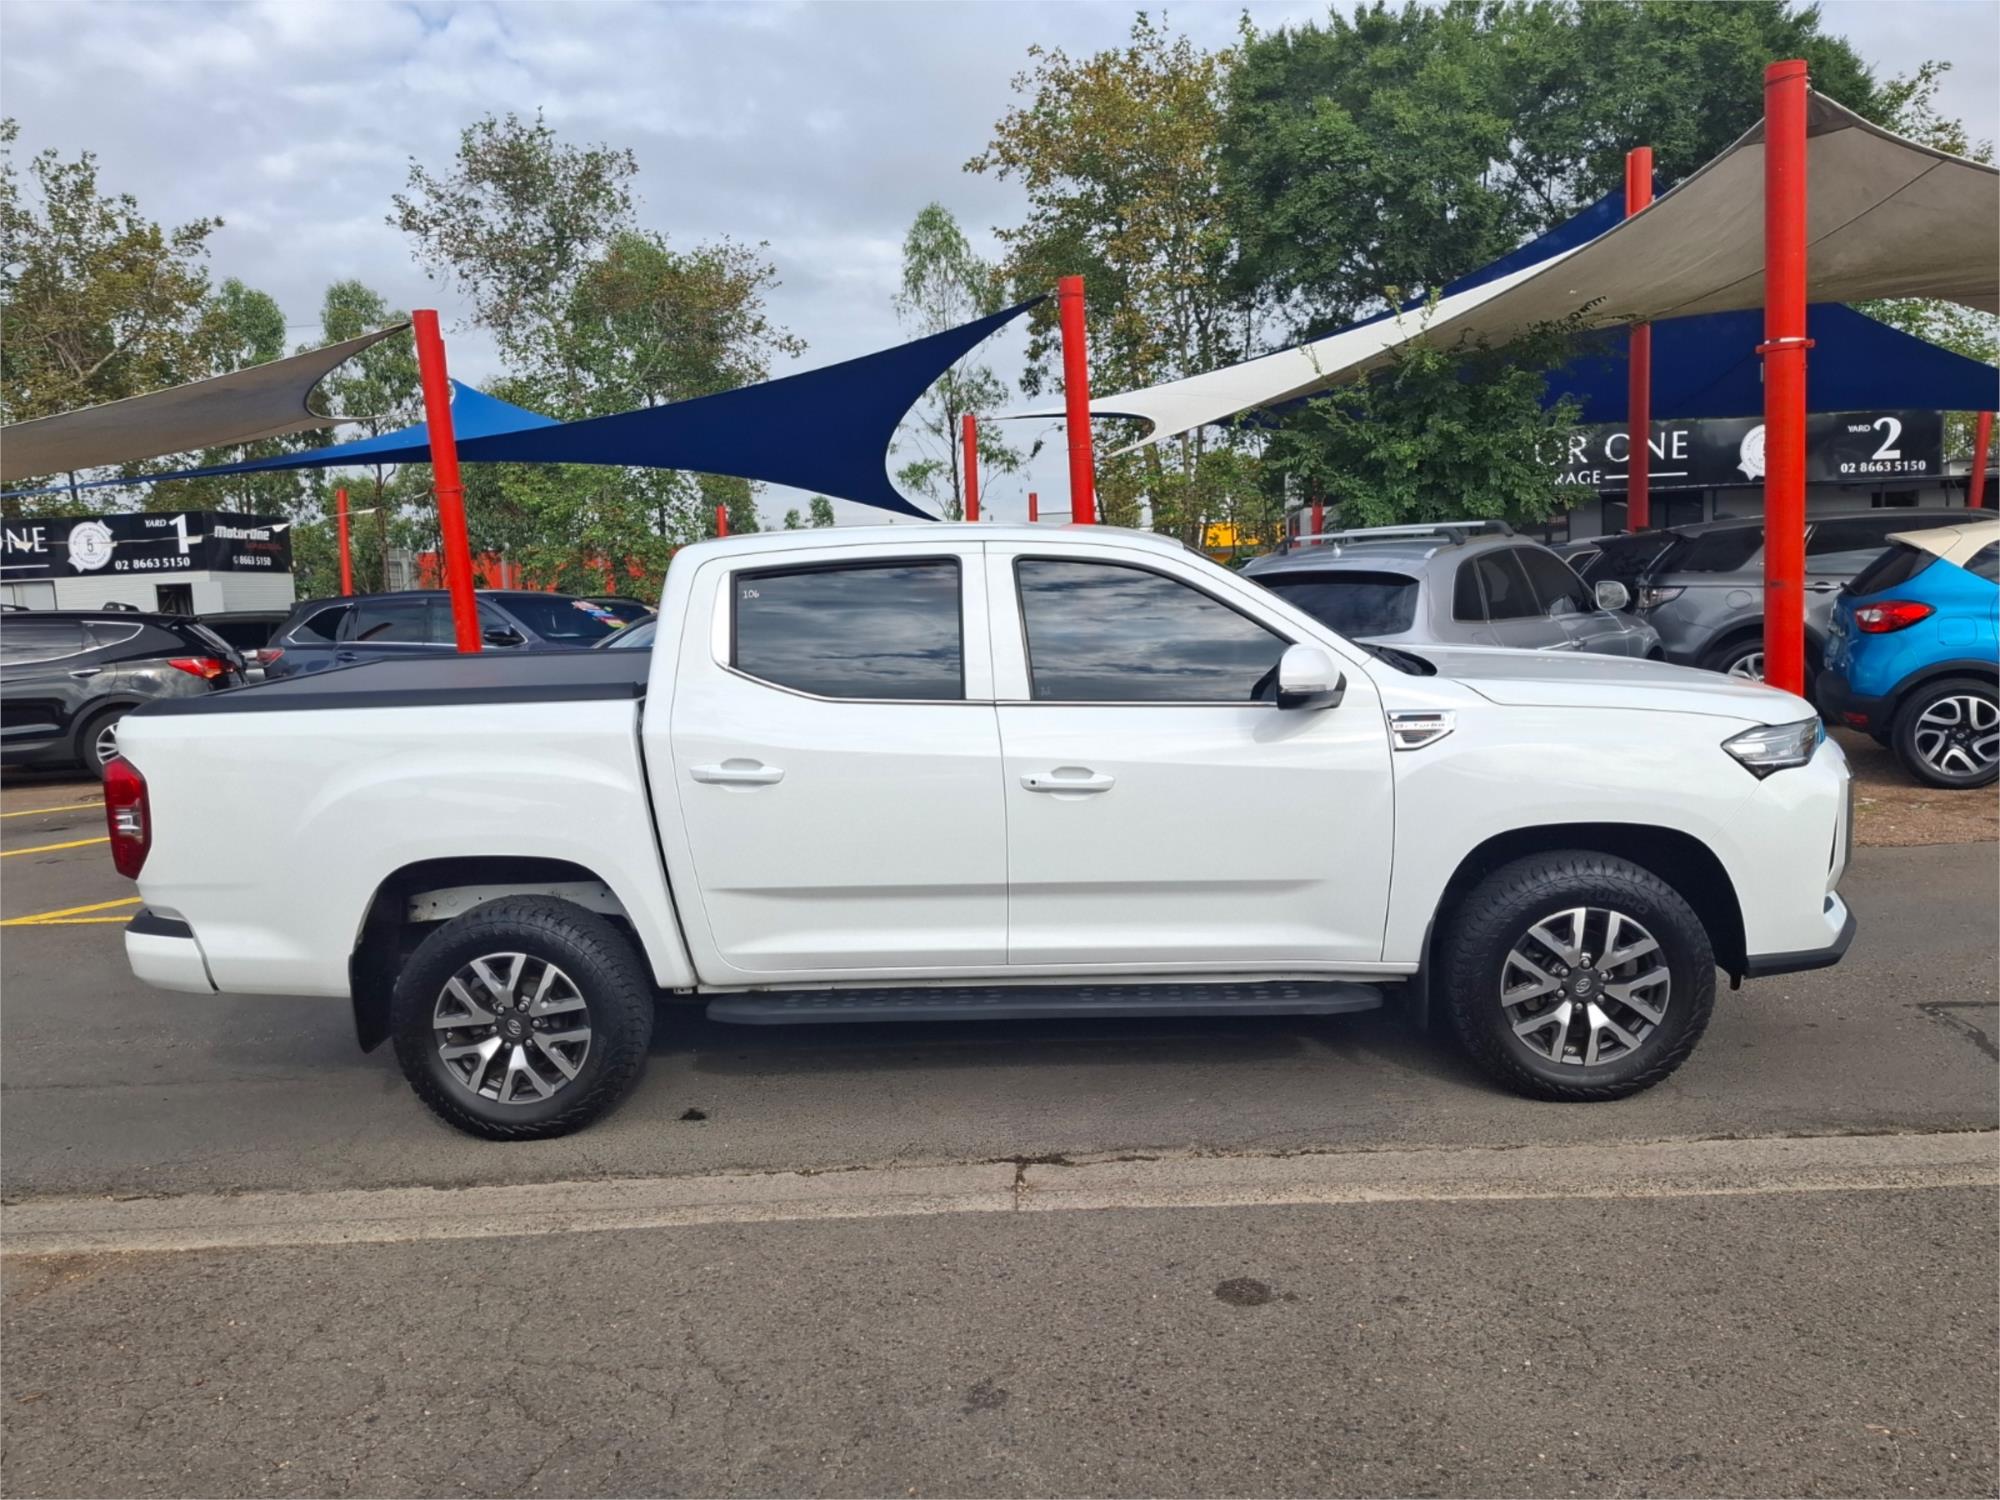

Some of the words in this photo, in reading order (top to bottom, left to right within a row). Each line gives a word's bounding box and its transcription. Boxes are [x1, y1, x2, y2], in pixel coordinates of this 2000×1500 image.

[1847, 424, 1871, 433] YARD
[1872, 416, 1902, 460] 2
[1840, 462, 1856, 474] 02
[1860, 461, 1891, 473] 8663
[1894, 460, 1926, 472] 5150
[144, 519, 167, 529] YARD
[168, 513, 189, 554] 1
[114, 560, 129, 571] 02
[132, 558, 160, 570] 8663
[162, 556, 191, 569] 5150
